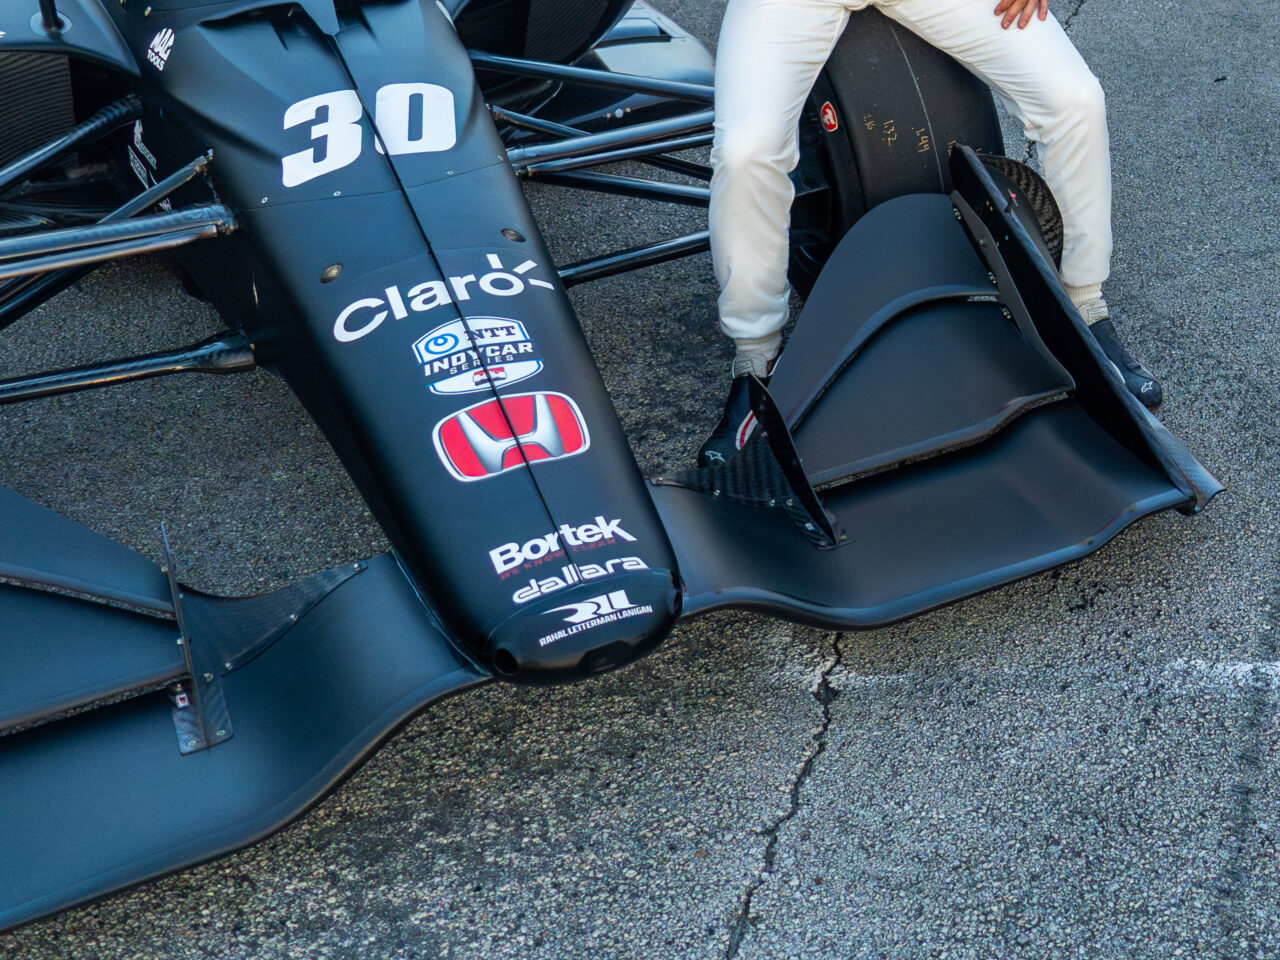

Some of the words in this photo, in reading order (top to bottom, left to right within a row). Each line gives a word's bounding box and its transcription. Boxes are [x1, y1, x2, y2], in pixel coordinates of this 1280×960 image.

[147, 48, 166, 71] TOOLS
[150, 27, 175, 61] MAC
[281, 82, 457, 188] 30
[333, 254, 555, 343] Claro
[464, 325, 516, 341] NTT
[424, 342, 534, 376] INDYCAR
[449, 354, 514, 375] SERIES
[489, 515, 638, 575] Bortek
[572, 538, 616, 552] CLEAN
[512, 556, 650, 605] dallara
[539, 630, 568, 647] RAHAL
[567, 613, 618, 635] LETTERMAN
[617, 605, 653, 620] LANIGAN
